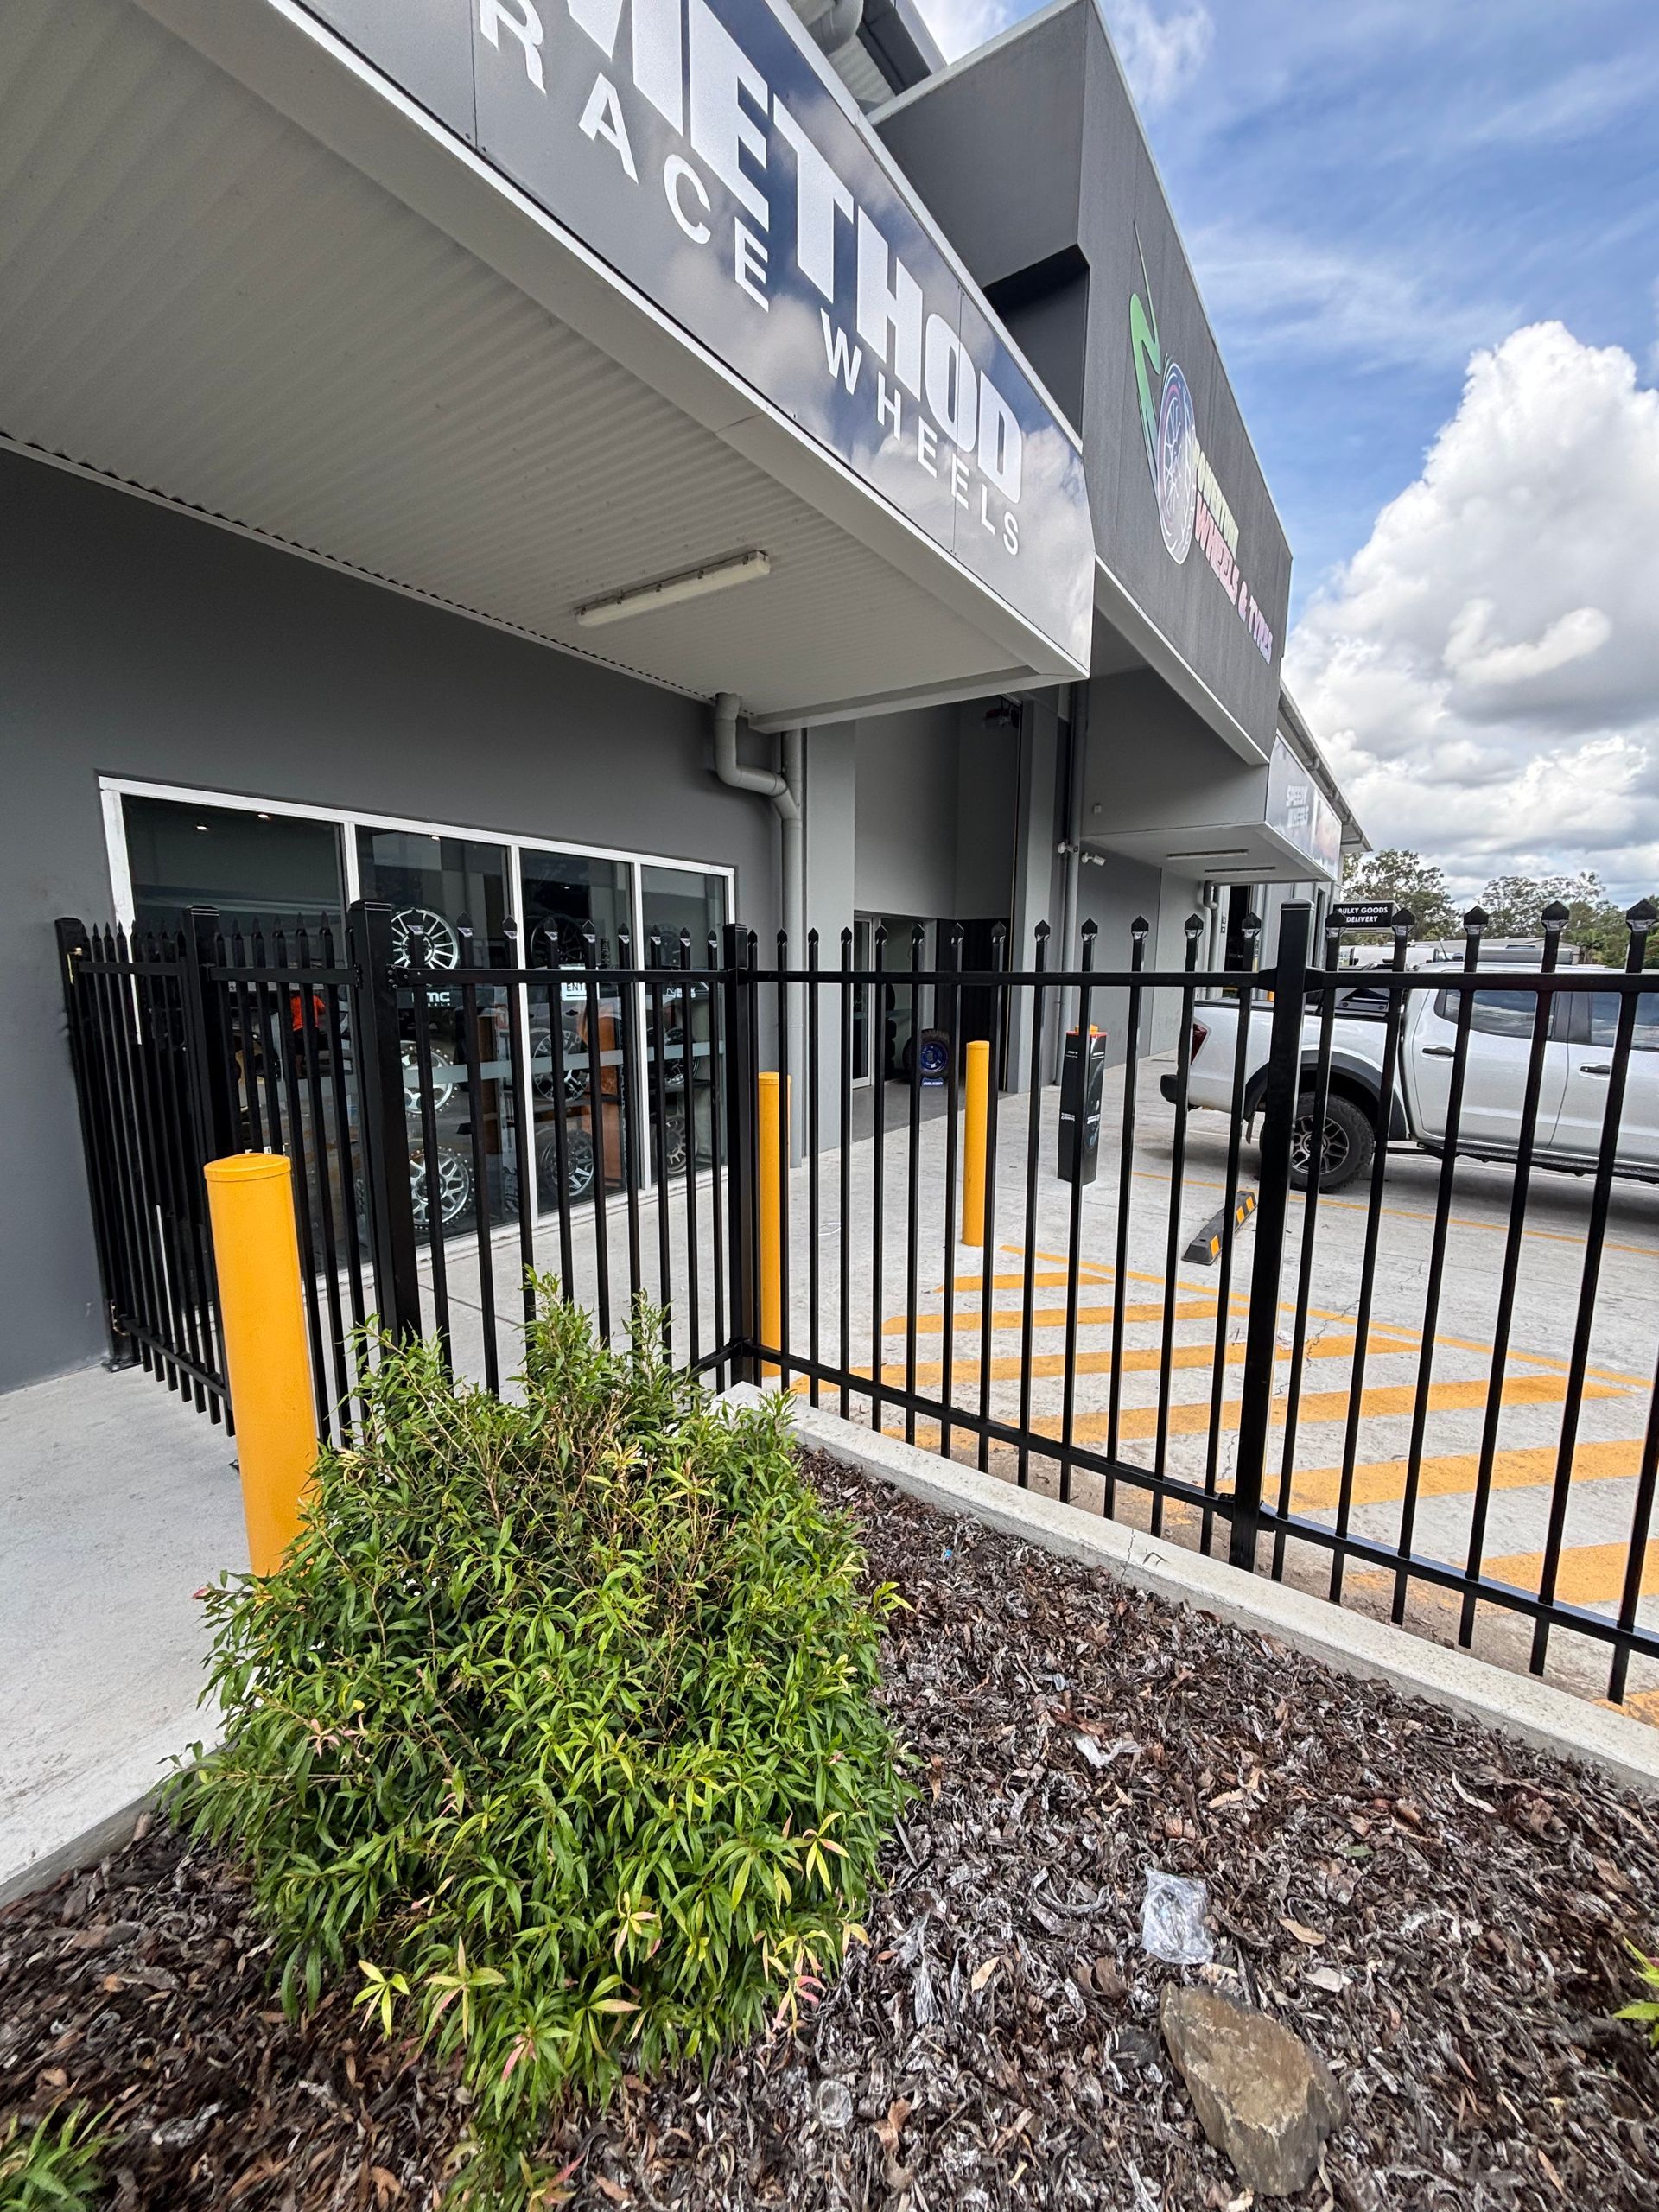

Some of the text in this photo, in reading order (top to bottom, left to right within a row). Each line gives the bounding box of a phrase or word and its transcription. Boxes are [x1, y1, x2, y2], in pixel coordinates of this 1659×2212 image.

[480, 0, 1020, 556] RACE WHEELS
[1194, 491, 1240, 606] WHEELS
[1249, 595, 1274, 665] TYRES
